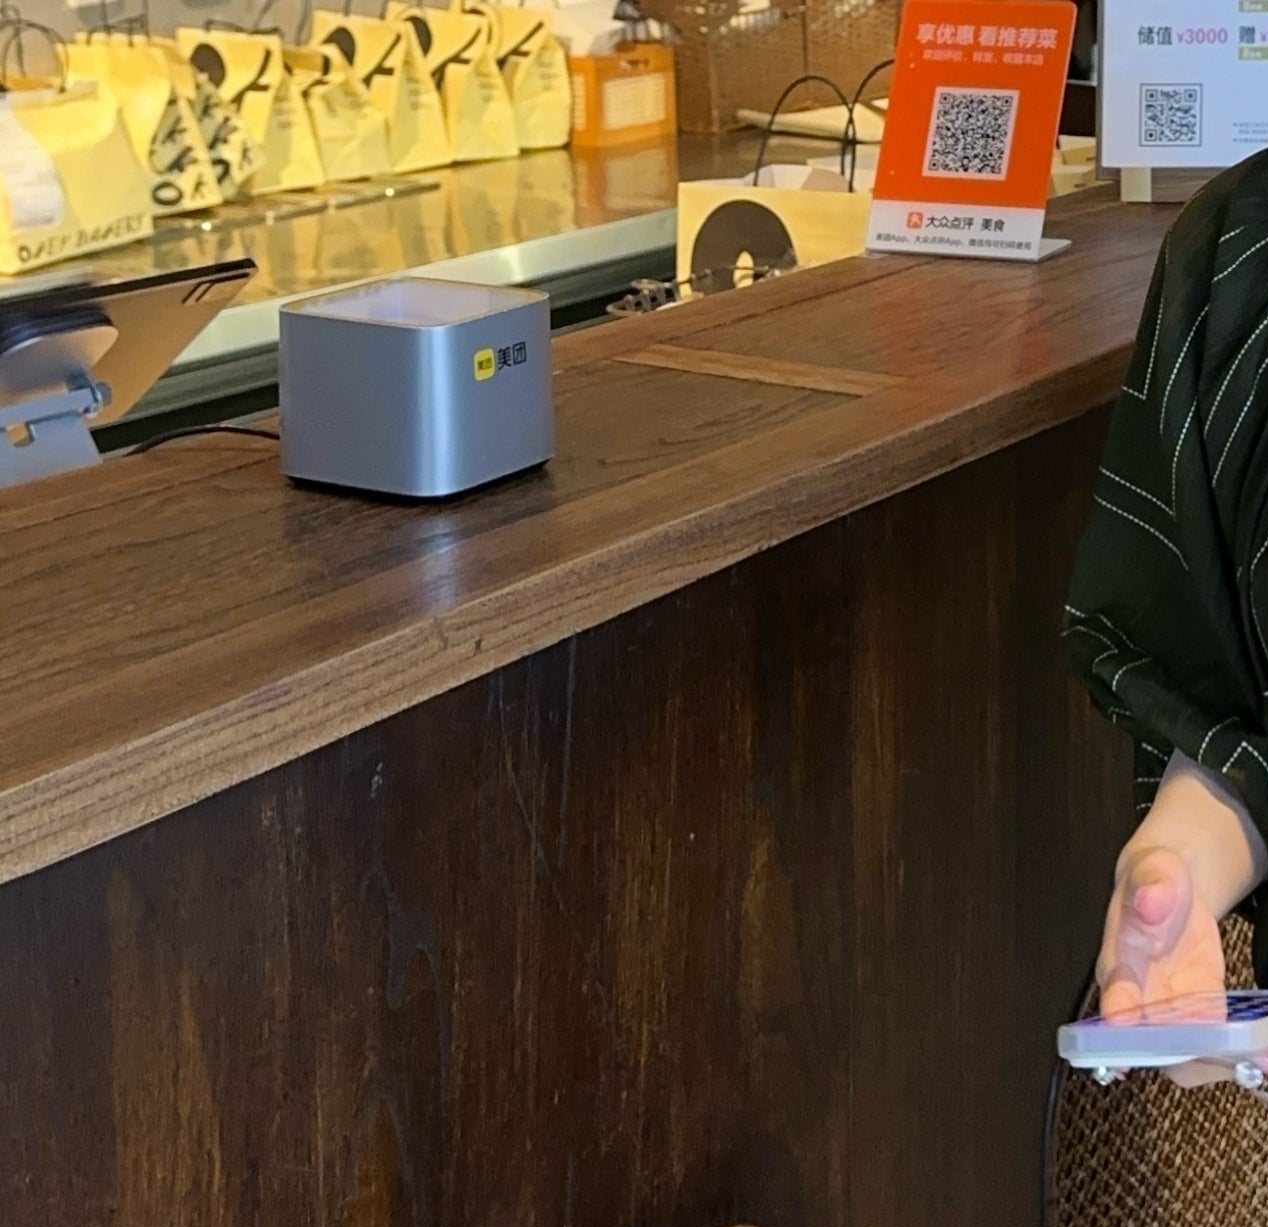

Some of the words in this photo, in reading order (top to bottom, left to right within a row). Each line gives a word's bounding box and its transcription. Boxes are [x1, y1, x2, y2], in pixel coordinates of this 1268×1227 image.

[917, 23, 975, 45] 享优惠
[978, 26, 1058, 49] 看推荐菜
[1137, 26, 1173, 45] 储值
[1177, 28, 1228, 44] ¥3000
[1239, 26, 1256, 45] 赠
[925, 215, 974, 230] 大众点评
[979, 218, 1005, 232] 美食
[497, 341, 527, 371] 美团
